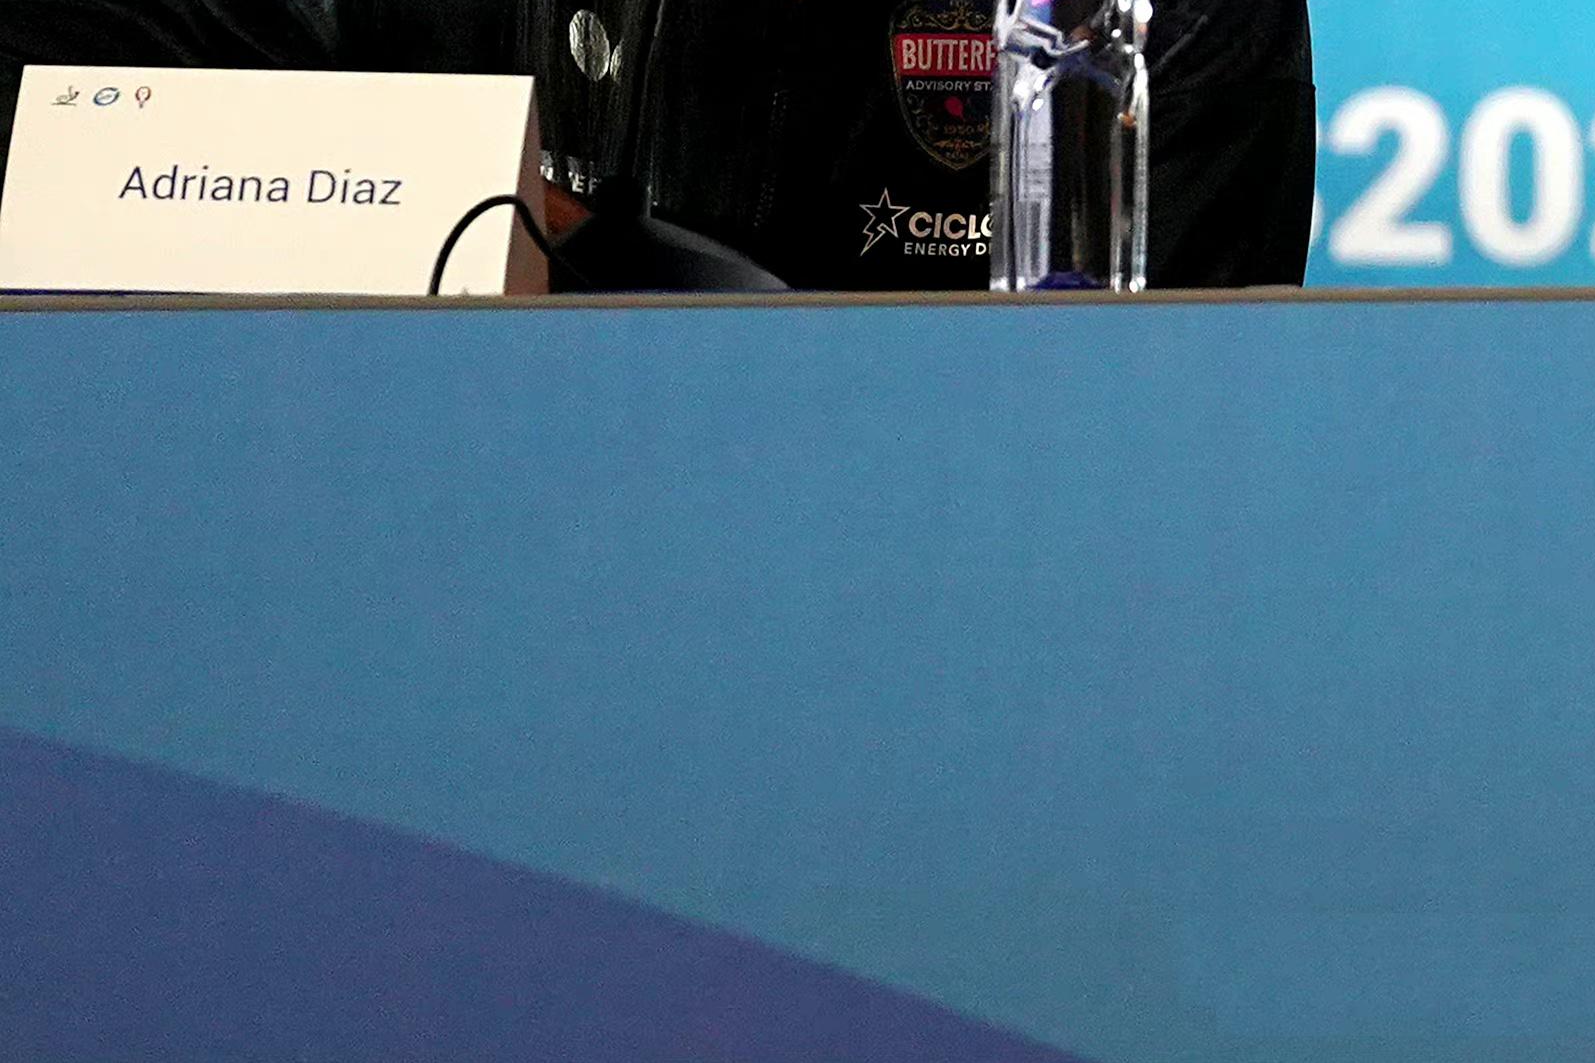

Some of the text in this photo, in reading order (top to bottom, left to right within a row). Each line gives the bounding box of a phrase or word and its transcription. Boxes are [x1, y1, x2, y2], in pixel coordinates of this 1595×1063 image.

[906, 80, 971, 92] ADVISORY
[118, 164, 403, 206] Adriana Diaz
[904, 242, 993, 257] ENERGY D
